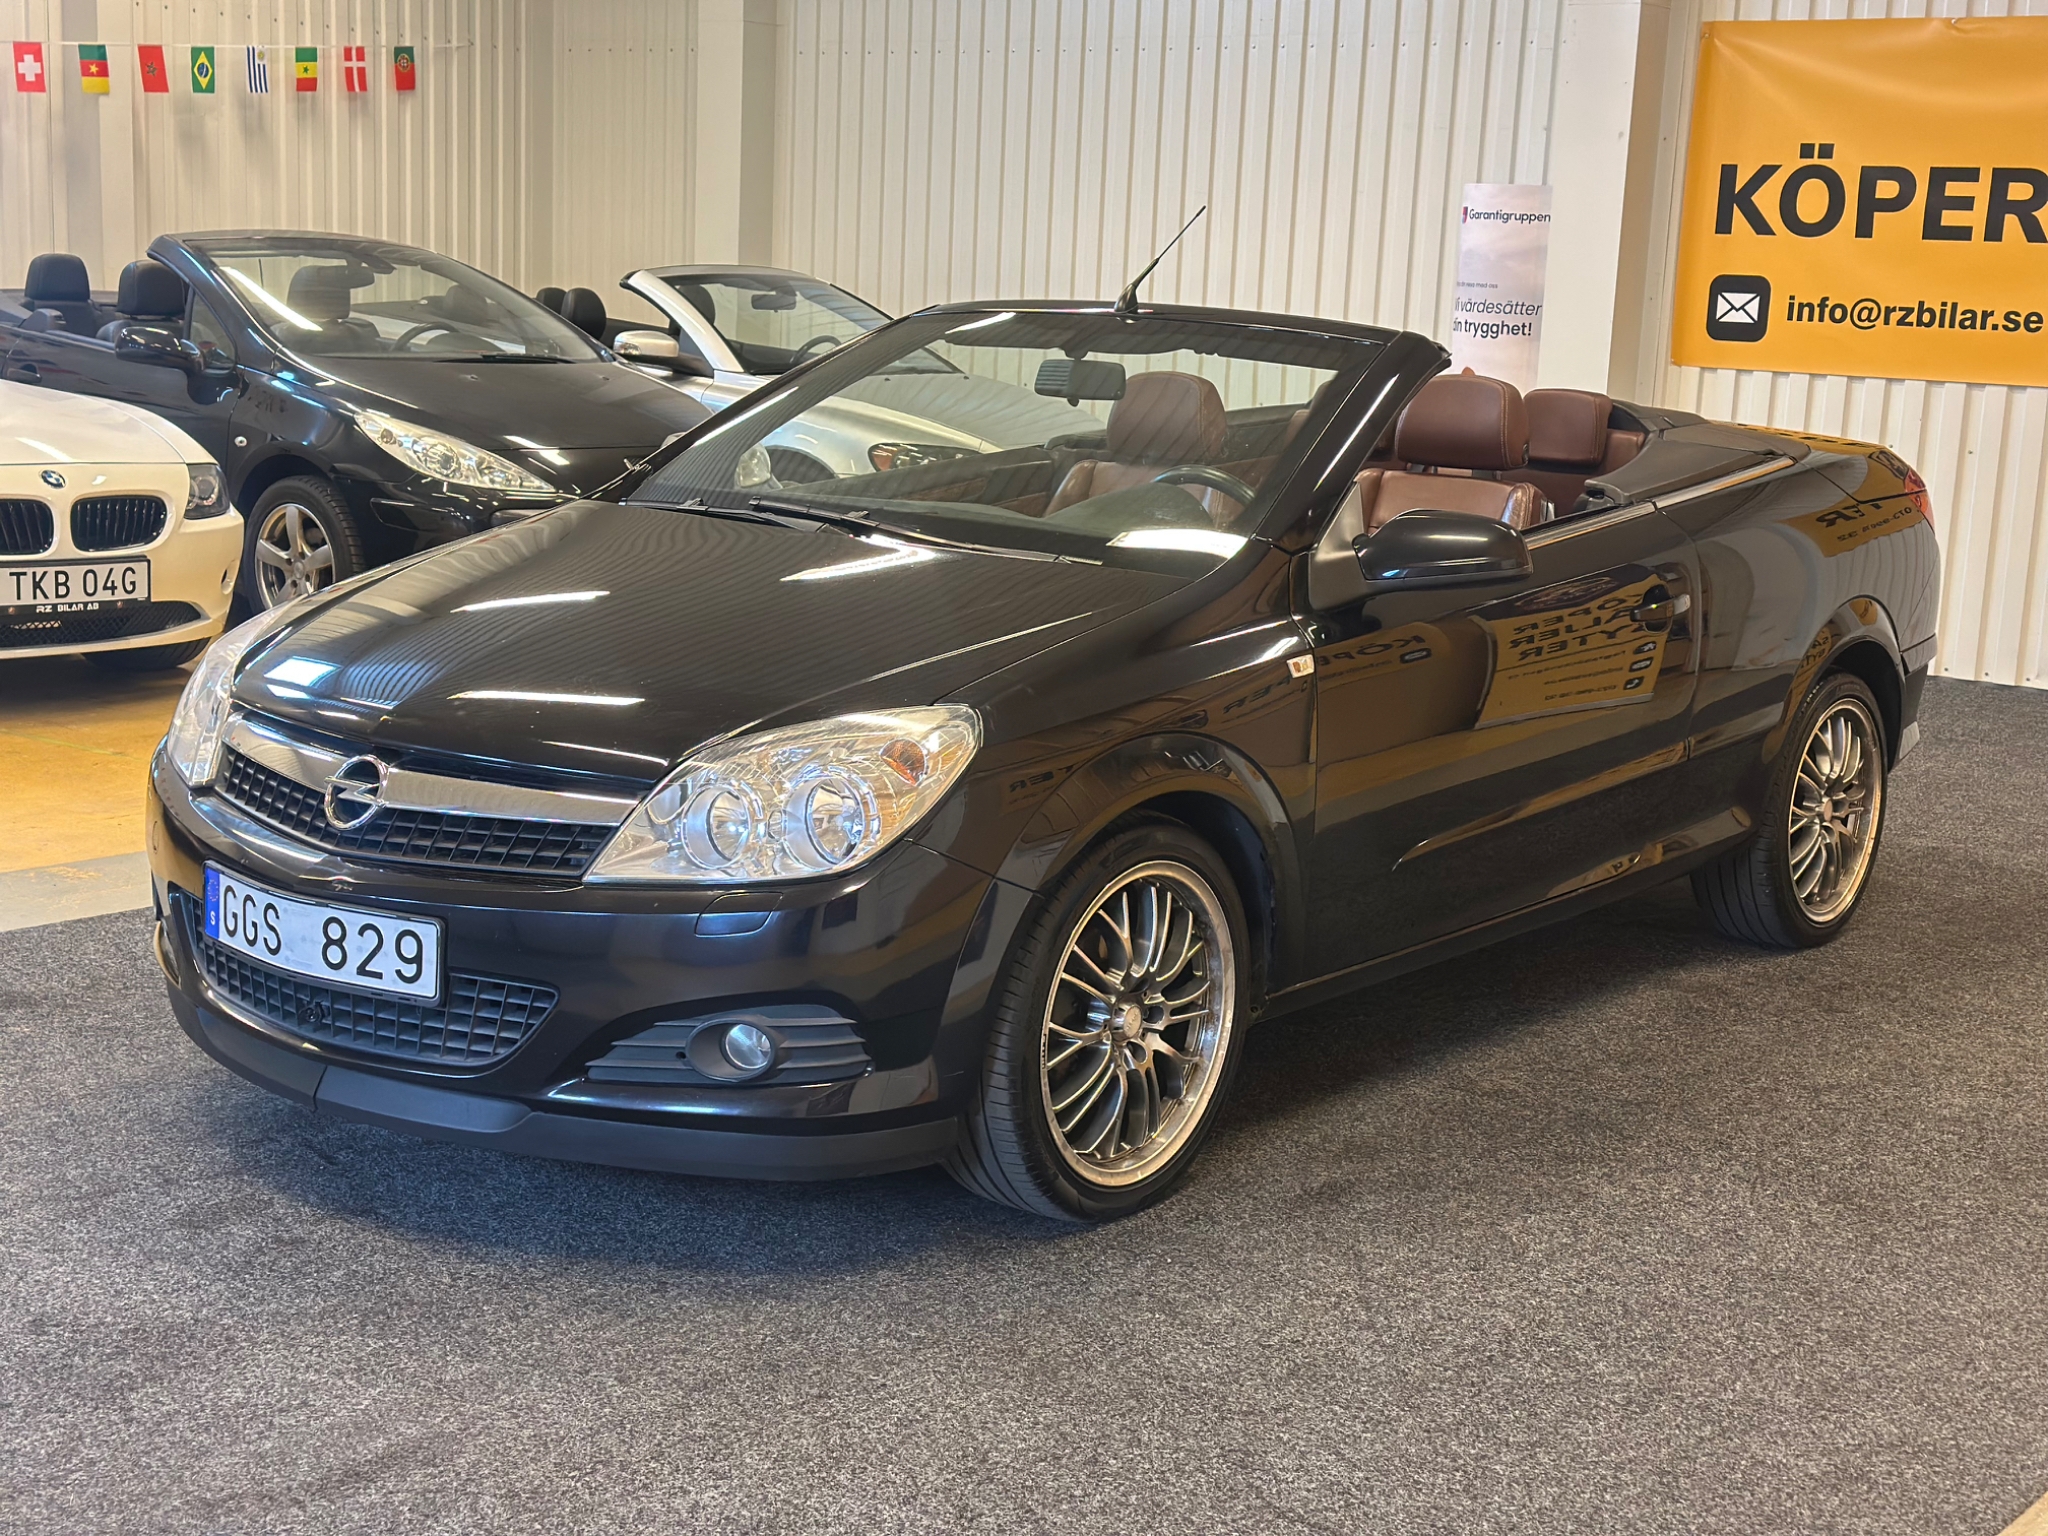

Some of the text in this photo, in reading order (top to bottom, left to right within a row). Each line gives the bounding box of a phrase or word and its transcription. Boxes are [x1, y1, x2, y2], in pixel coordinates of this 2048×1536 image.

[1714, 143, 2048, 243] KÖPER
[1469, 208, 1551, 225] Garantigruppen
[1460, 298, 1542, 316] värdesätter
[1787, 295, 2044, 333] info@rzbilar.se
[1464, 318, 1532, 339] trygghet!
[9, 566, 136, 600] TKB 04G
[36, 602, 99, 613] RZ BILAR AB
[210, 911, 216, 925] S
[223, 885, 423, 984] GGS 829
